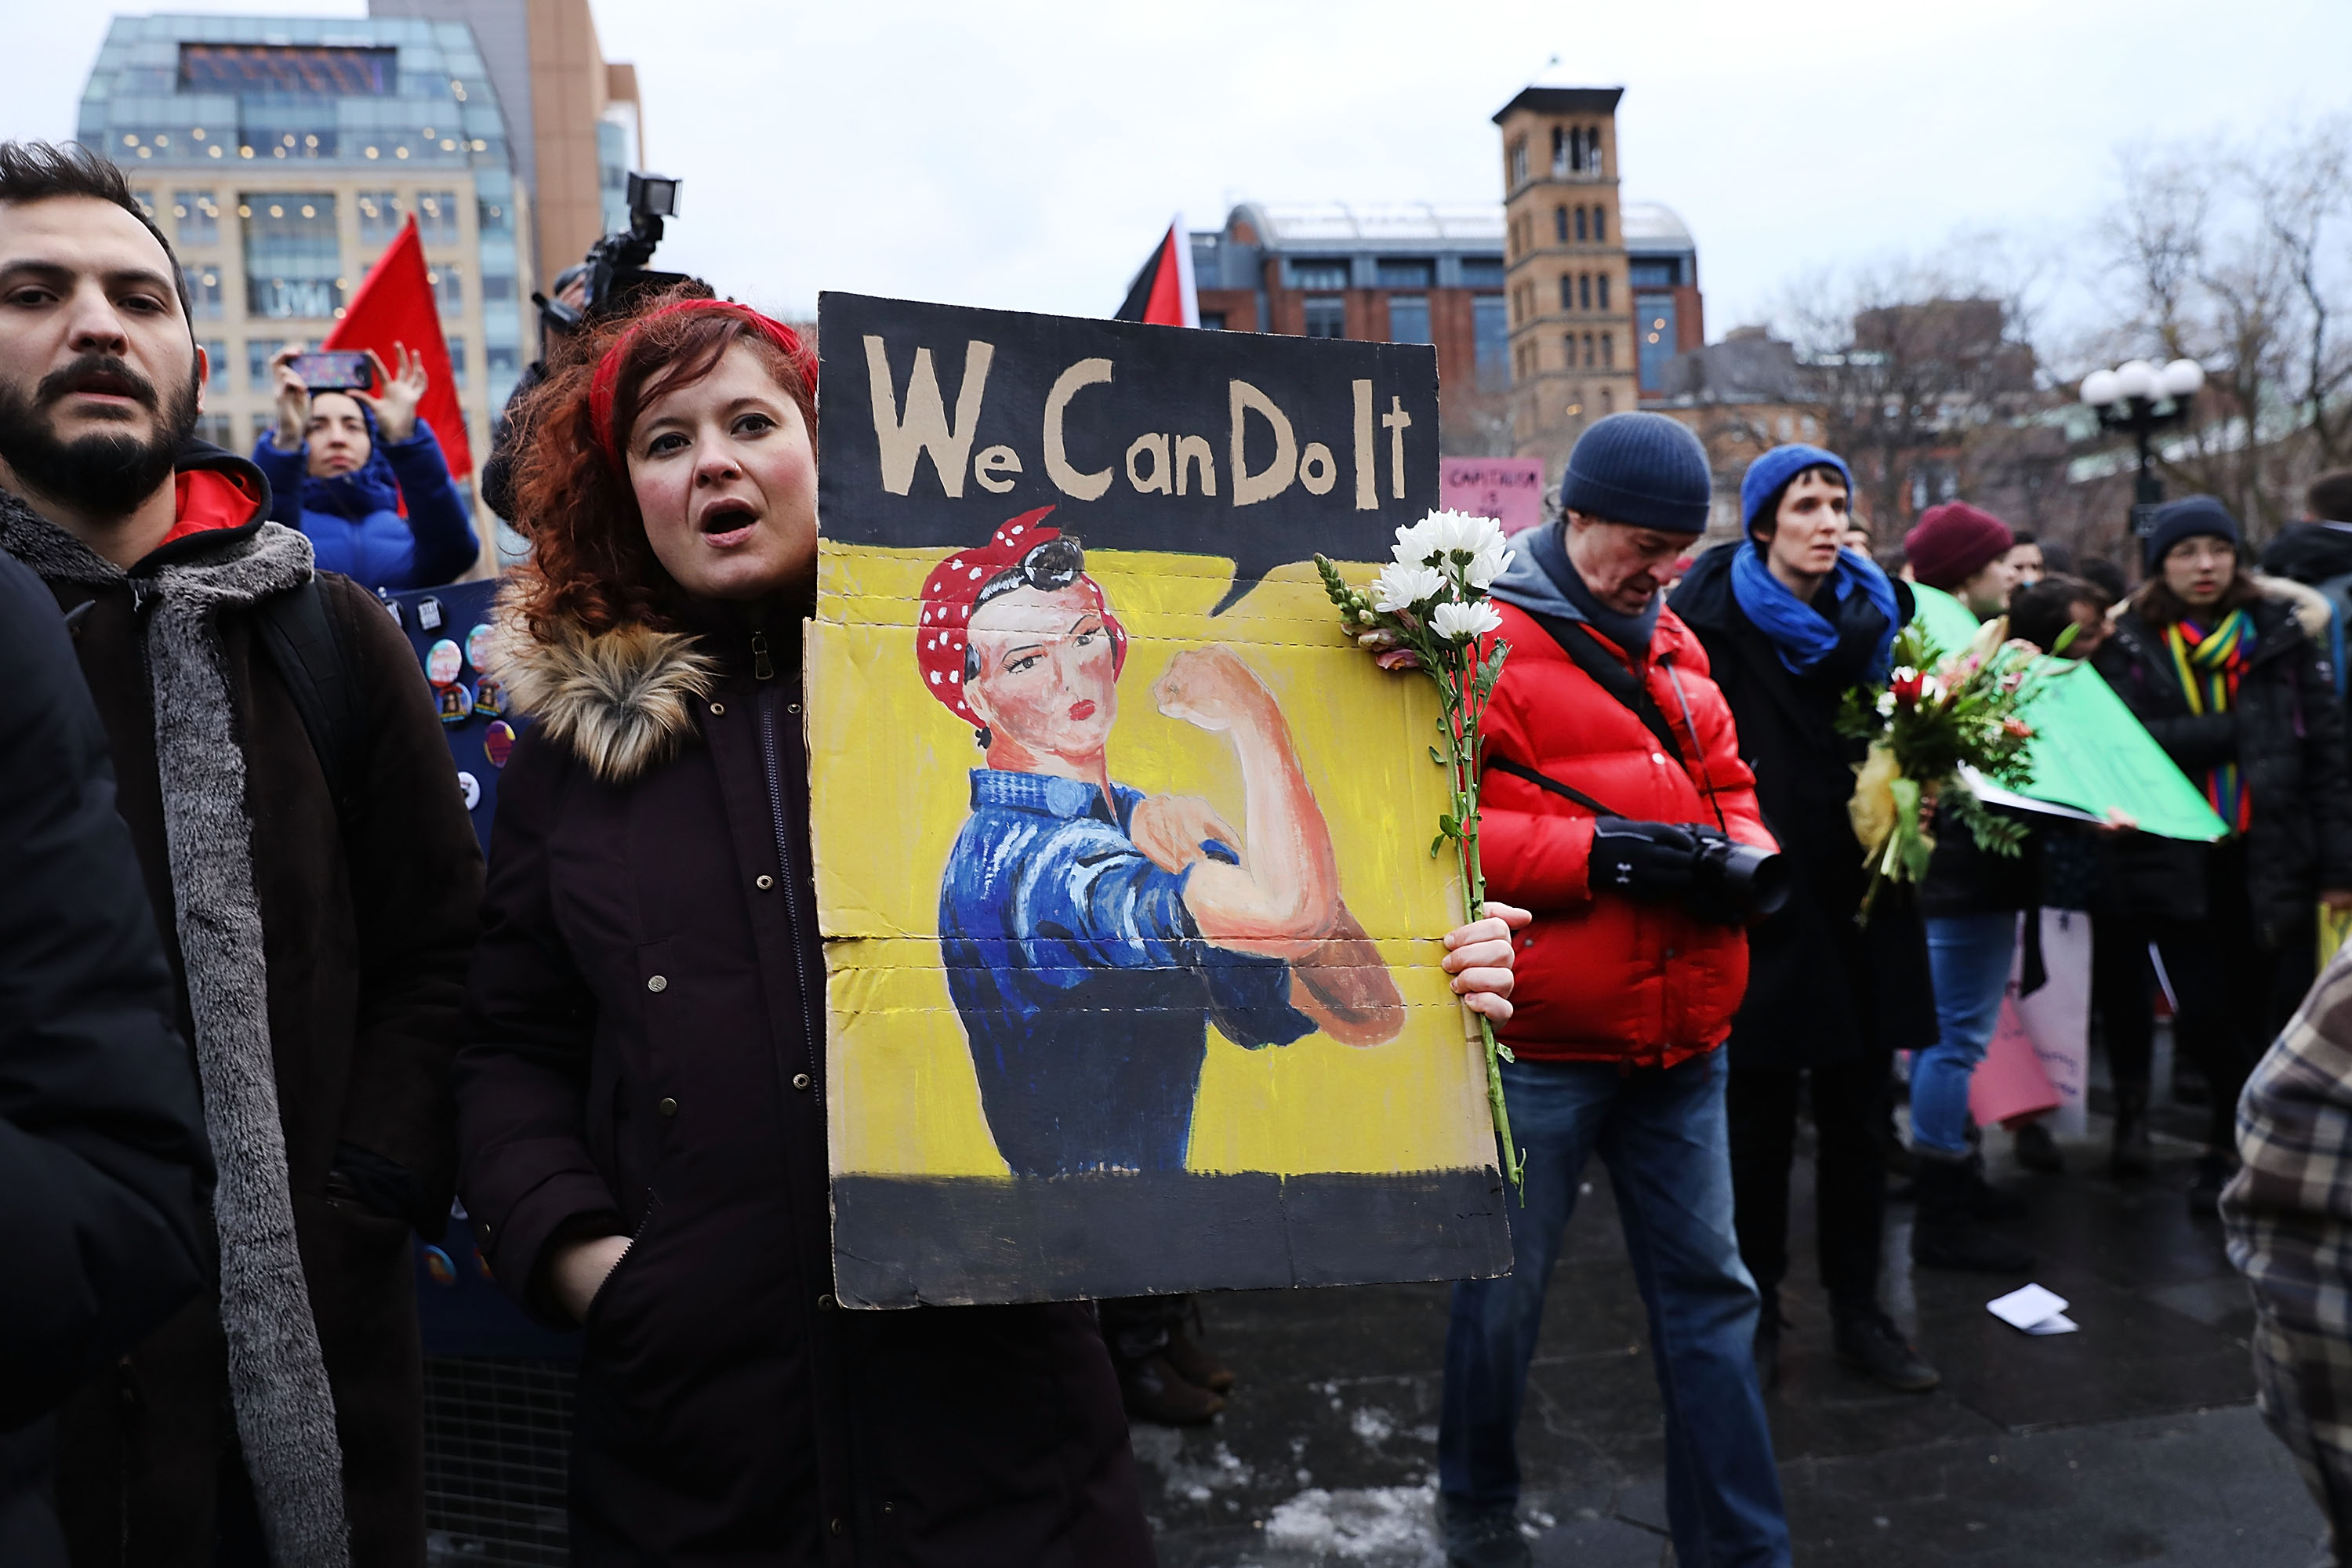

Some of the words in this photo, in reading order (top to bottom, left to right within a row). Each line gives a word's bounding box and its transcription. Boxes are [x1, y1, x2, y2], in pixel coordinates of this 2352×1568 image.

[863, 335, 1023, 498] We
[1044, 358, 1217, 501] Can
[1229, 379, 1338, 507] Do
[1352, 379, 1412, 510] It
[1449, 468, 1538, 488] CAPITALISM
